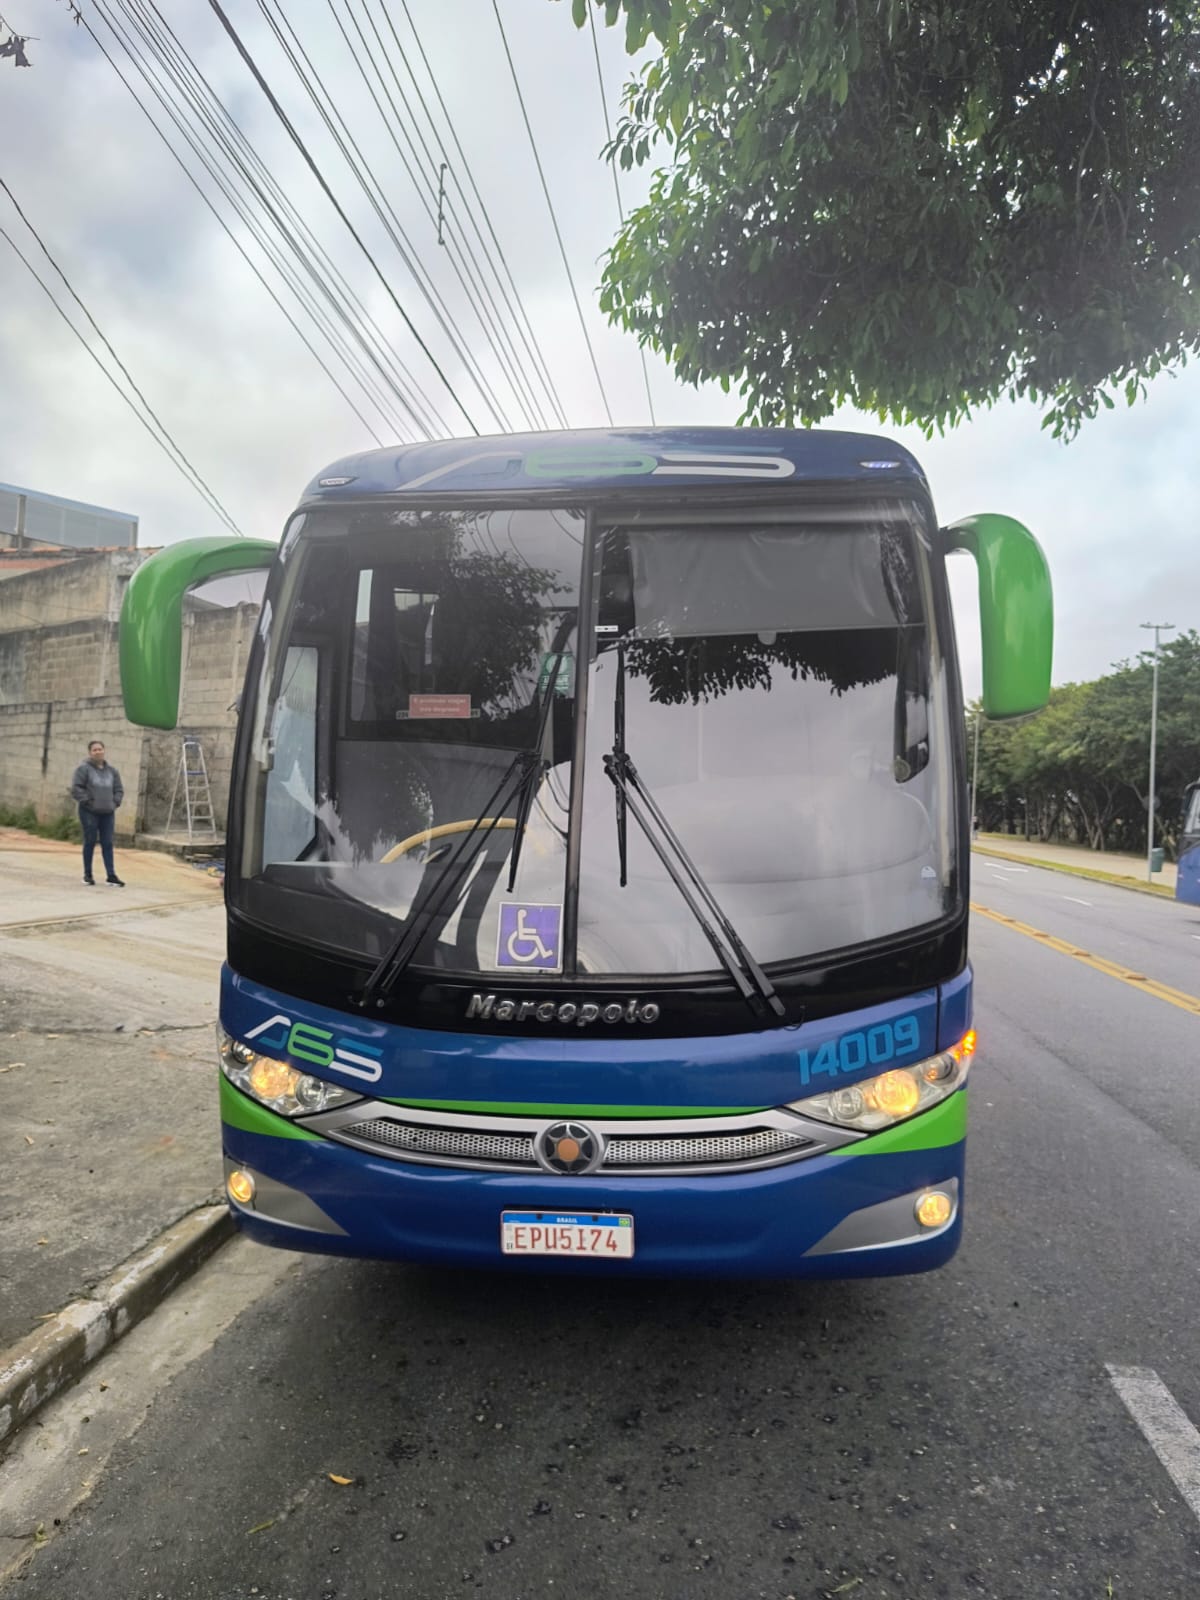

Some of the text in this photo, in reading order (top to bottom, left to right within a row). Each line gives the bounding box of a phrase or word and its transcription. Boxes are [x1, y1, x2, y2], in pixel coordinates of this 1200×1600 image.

[465, 993, 661, 1027] Marcopolo
[797, 1014, 921, 1086] 14009
[556, 1217, 577, 1225] BRASIL
